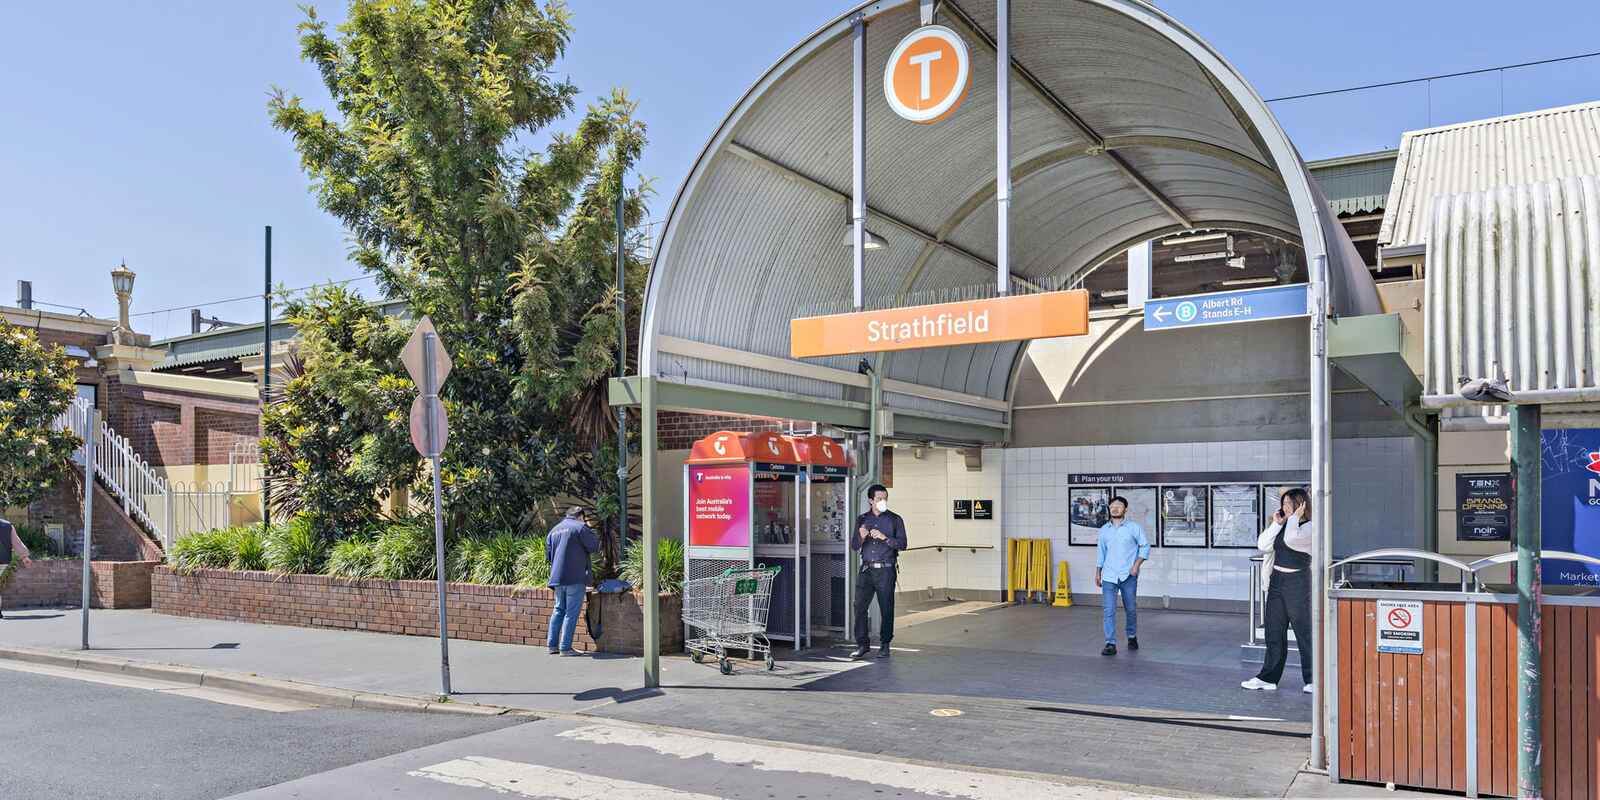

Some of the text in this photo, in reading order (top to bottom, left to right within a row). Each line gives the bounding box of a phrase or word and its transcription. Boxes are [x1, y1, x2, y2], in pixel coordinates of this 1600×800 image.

[908, 50, 942, 101] T
[1202, 298, 1243, 309] Albert Rd
[1183, 307, 1191, 317] B
[1202, 306, 1252, 318] Stands E-H
[867, 310, 989, 342] Strathfield
[1111, 474, 1124, 482] trip
